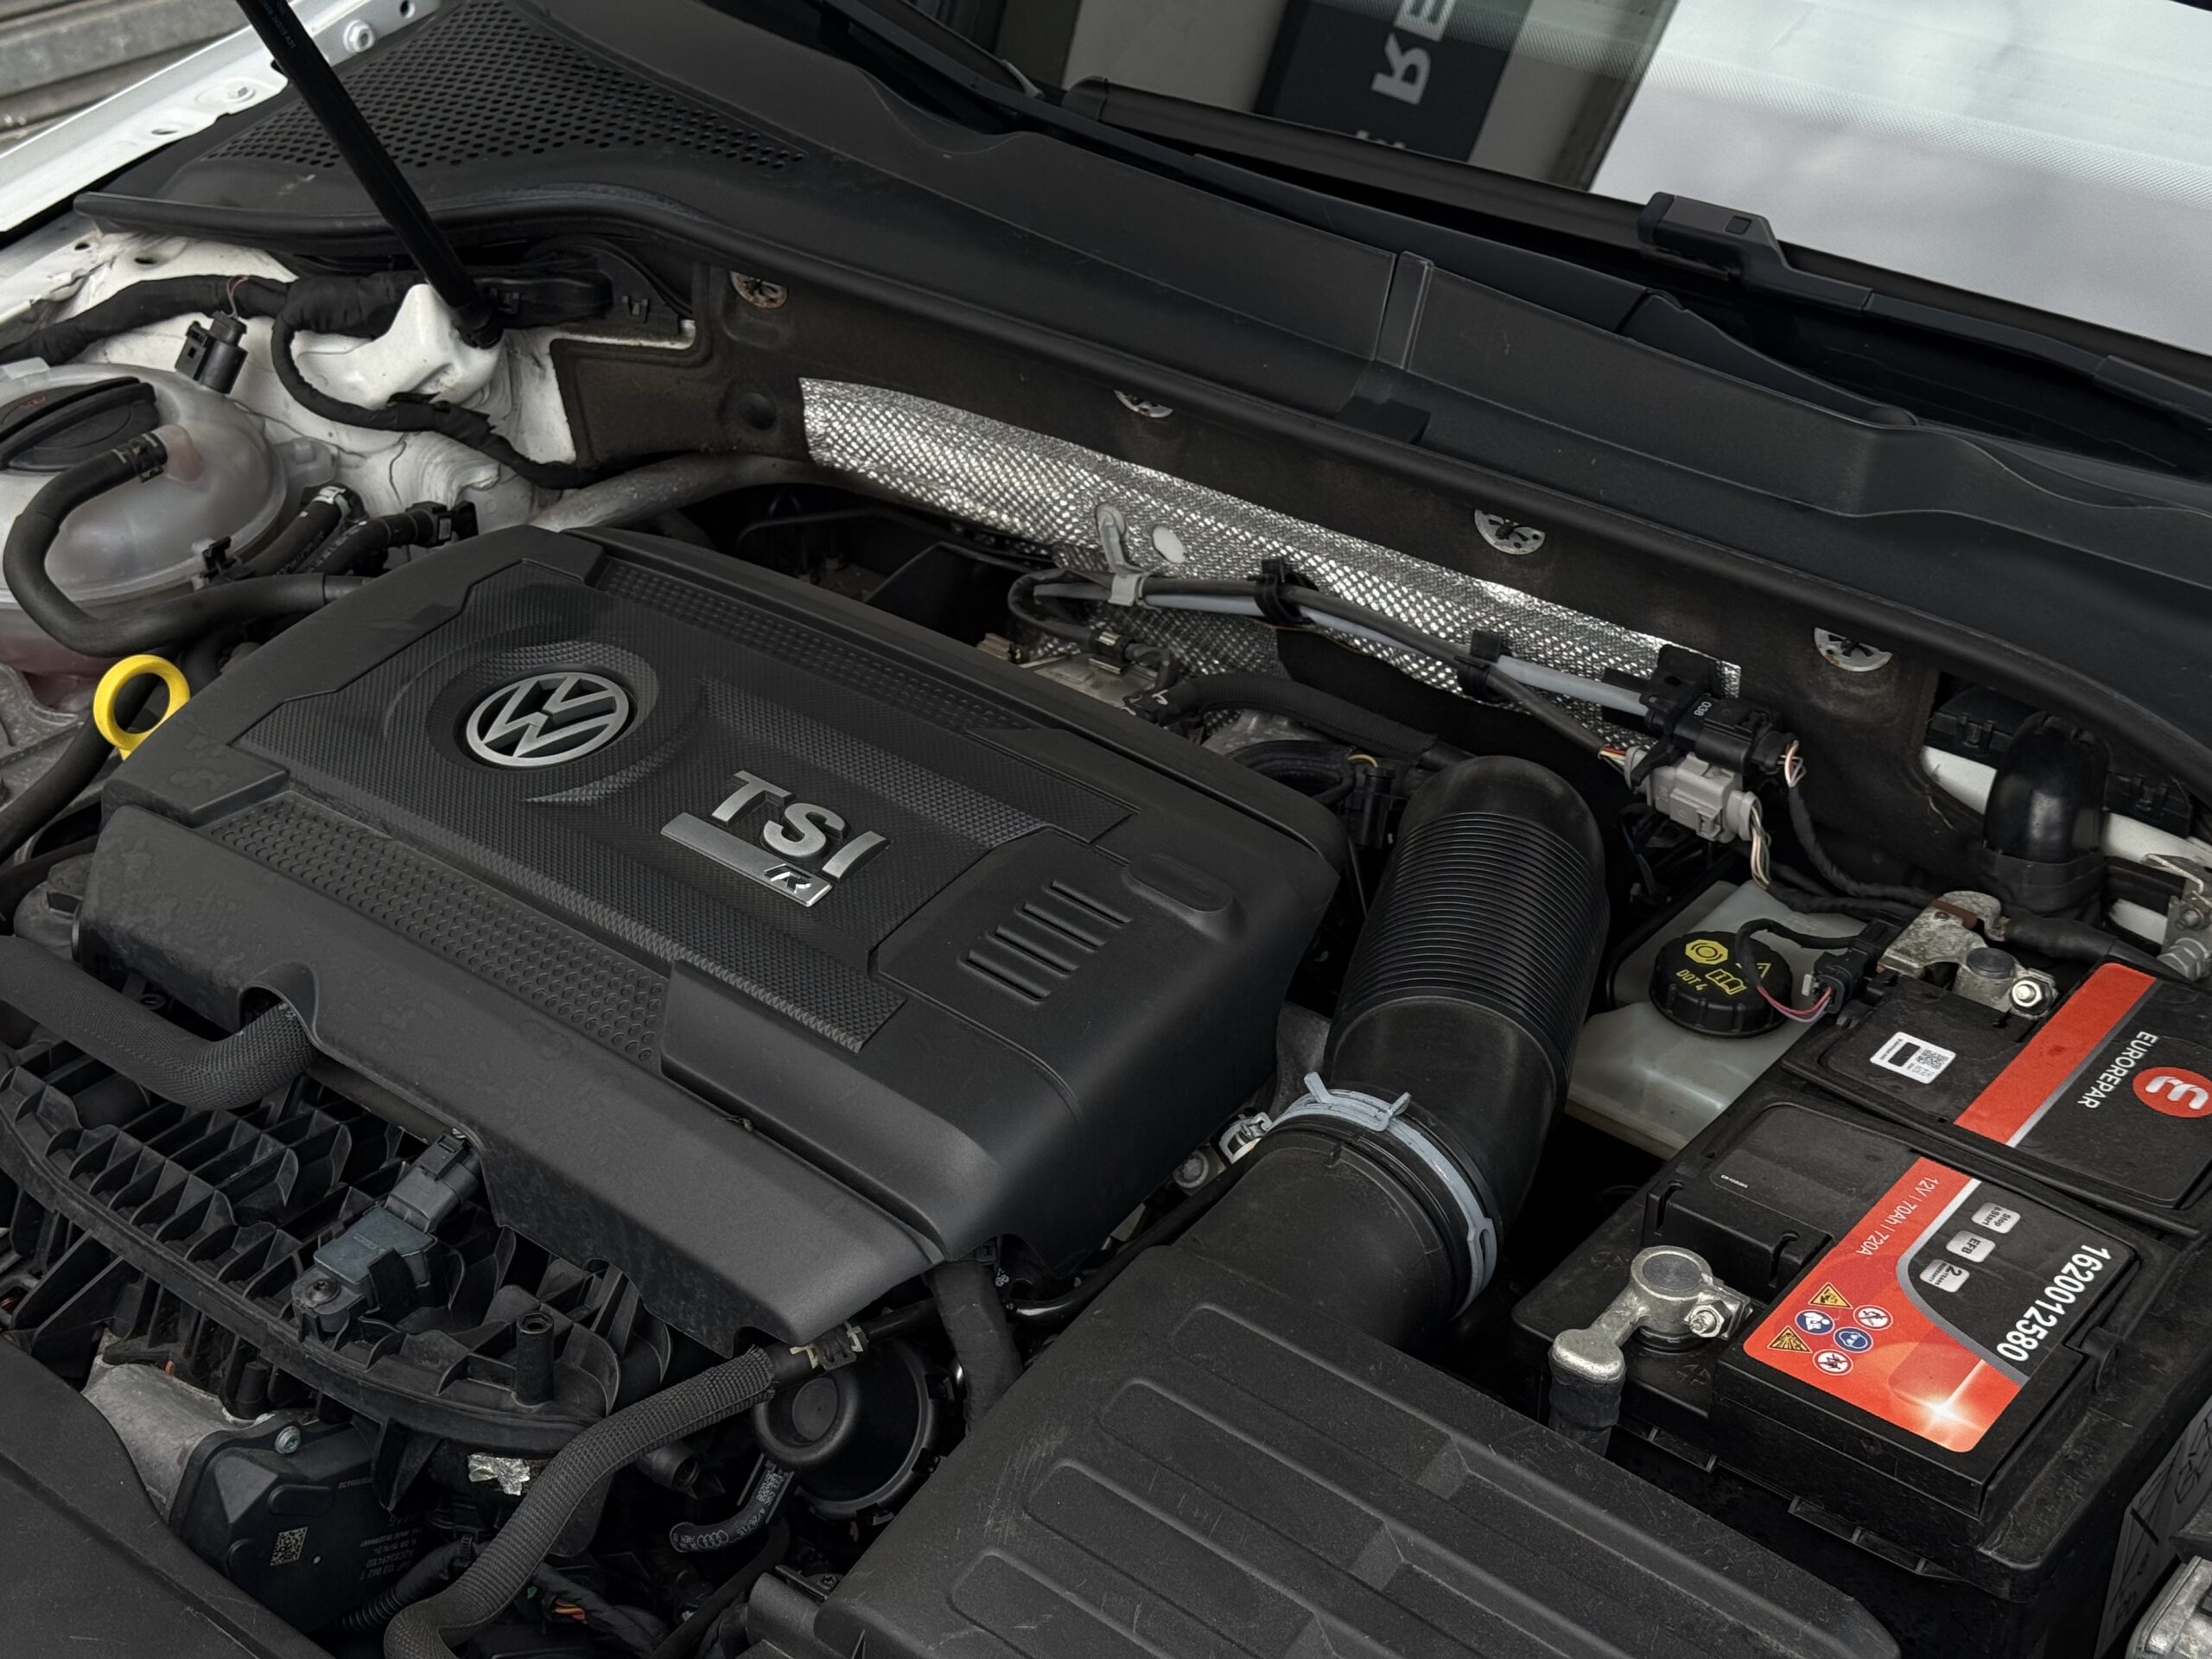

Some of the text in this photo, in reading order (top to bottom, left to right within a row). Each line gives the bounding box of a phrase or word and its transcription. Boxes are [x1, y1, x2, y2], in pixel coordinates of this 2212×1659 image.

[1694, 701, 1712, 716] 038
[711, 770, 888, 880] TSI
[1676, 969, 1701, 984] DOT
[2076, 1031, 2159, 1109] EUROREPAR
[1915, 1177, 1939, 1197] 12V
[1885, 1200, 1918, 1224] 70Ah
[1994, 1213, 2012, 1227] Stop
[1855, 1230, 1891, 1255] 720A
[1961, 1237, 1980, 1255] EFB
[1945, 1265, 1962, 1276] 2
[1997, 1244, 2112, 1362] 1620012580
